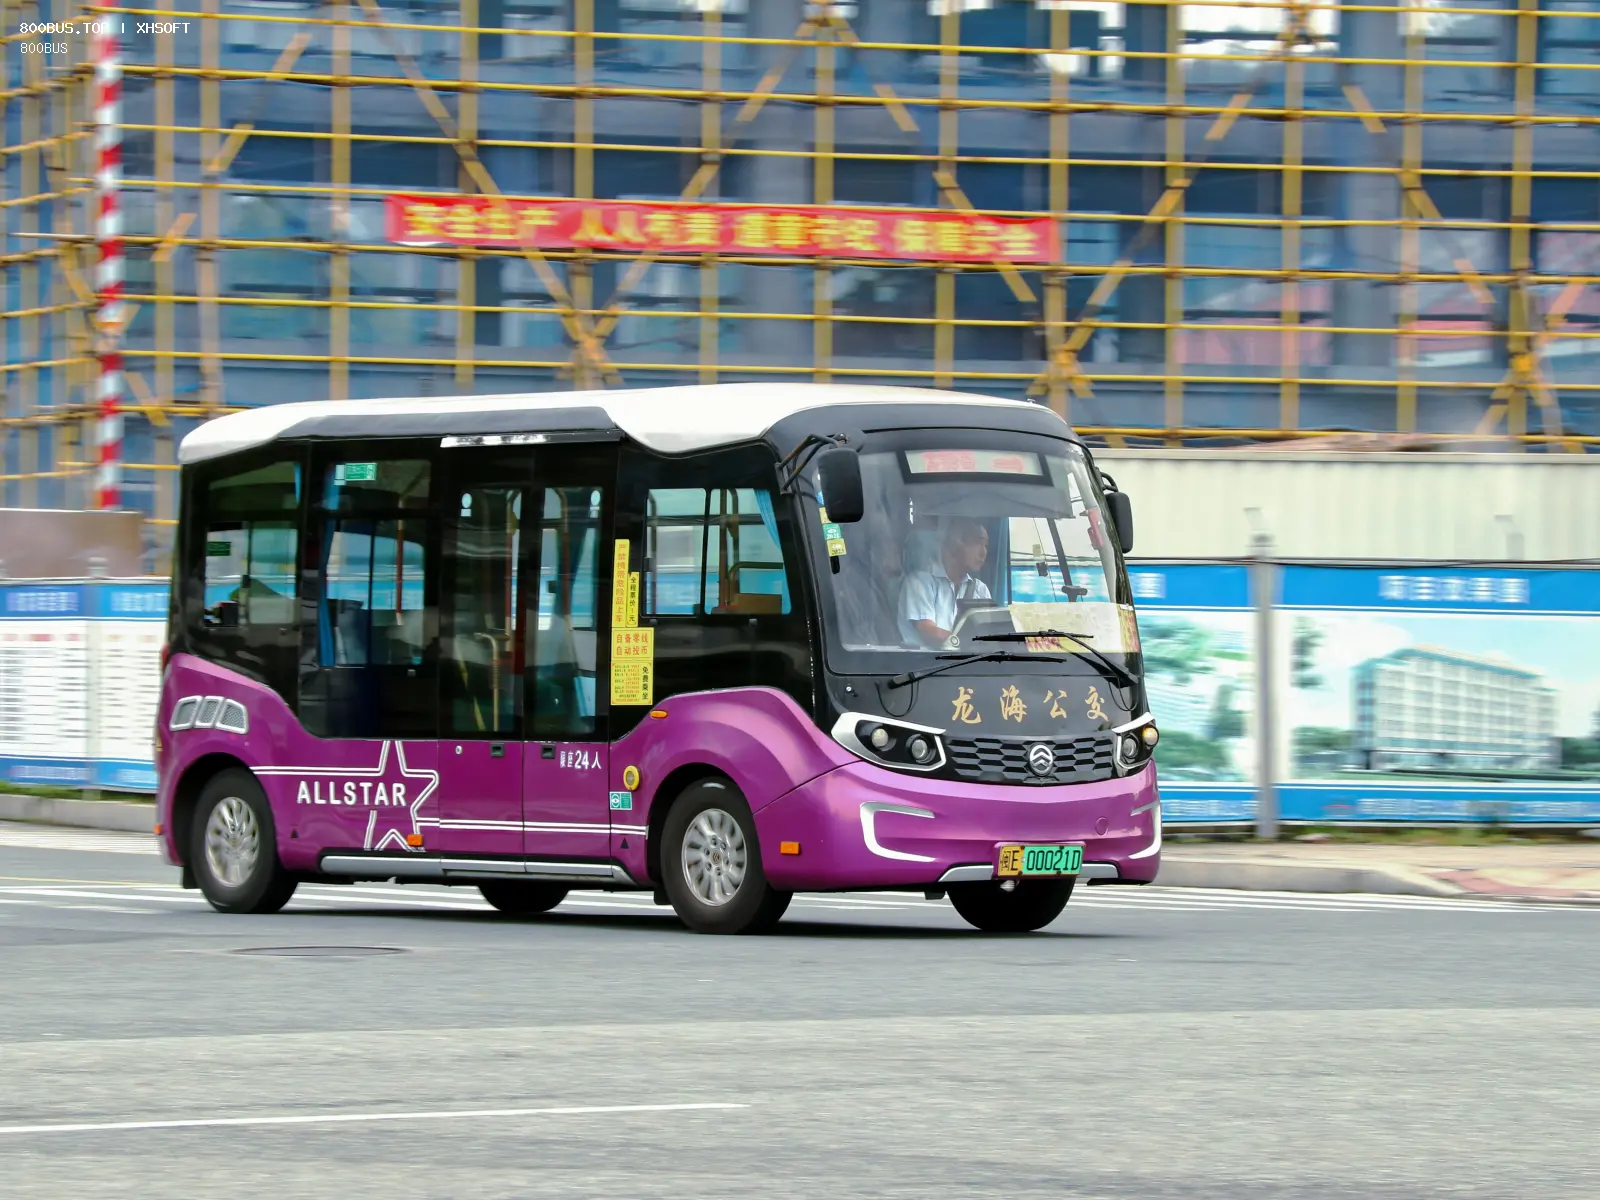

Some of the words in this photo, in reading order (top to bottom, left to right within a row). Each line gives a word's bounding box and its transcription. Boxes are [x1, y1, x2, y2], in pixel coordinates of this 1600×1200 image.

[616, 645, 648, 656] 自动投币
[951, 684, 1109, 724] 龙海公交
[297, 780, 407, 807] ALLSTAR
